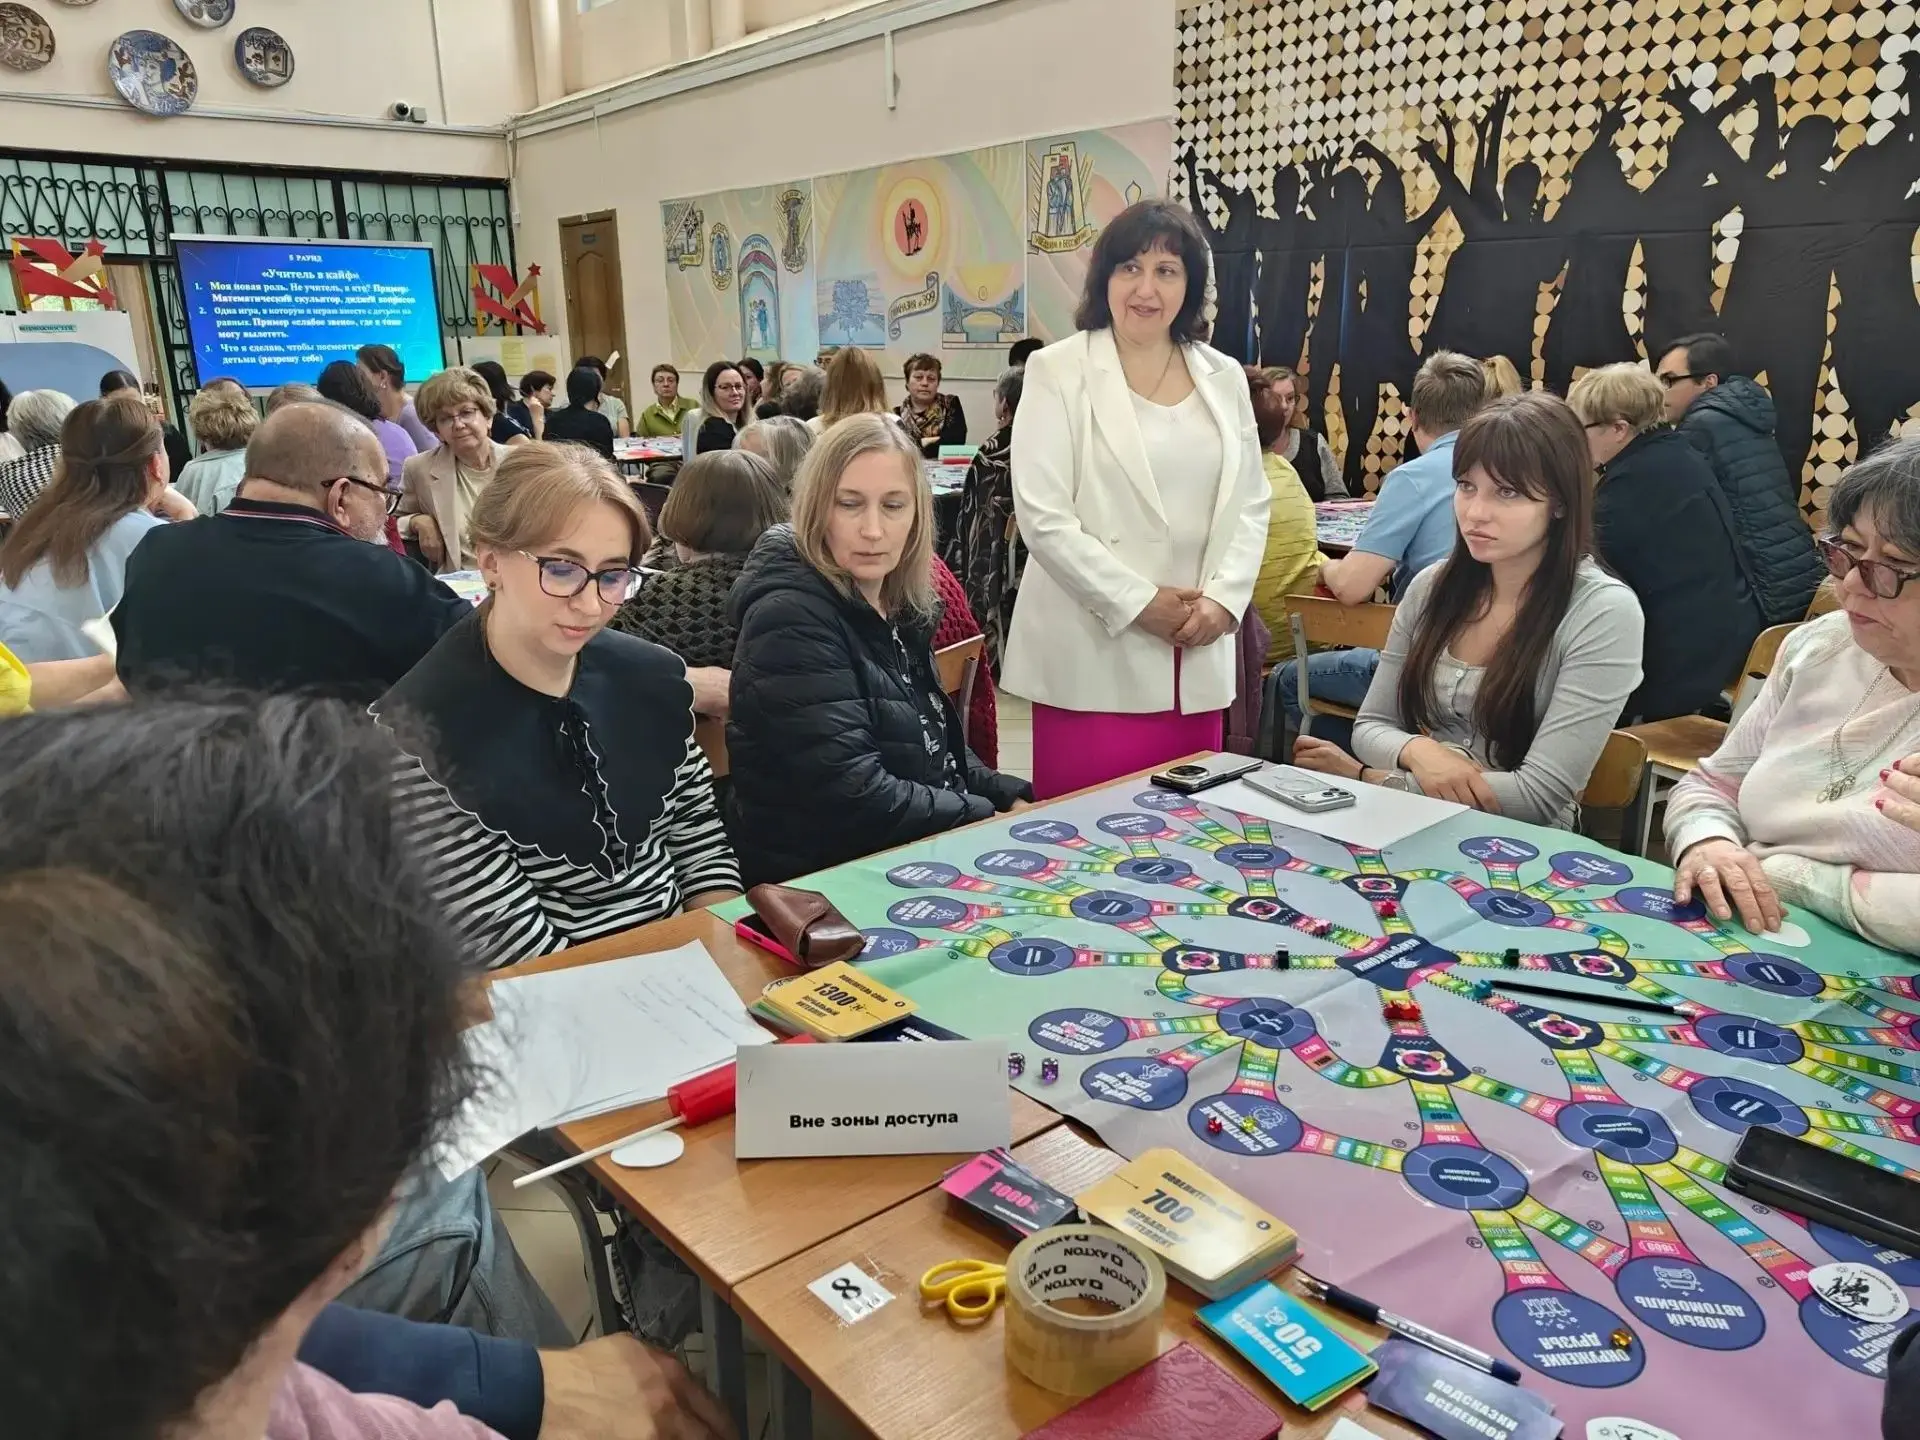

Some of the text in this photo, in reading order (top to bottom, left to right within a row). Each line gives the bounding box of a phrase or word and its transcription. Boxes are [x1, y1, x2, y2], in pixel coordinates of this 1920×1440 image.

[262, 269, 315, 279] «Учитель
[326, 271, 360, 281] кайф»
[210, 282, 231, 290] Моя
[212, 294, 292, 303] Математический
[214, 307, 236, 315] Одна
[238, 308, 260, 316] игра,
[252, 318, 289, 327] Пример
[218, 331, 240, 340] могу
[220, 344, 239, 352] Что
[222, 356, 256, 364] детьми
[302, 354, 323, 364] себе)
[813, 982, 858, 1007] 1300
[789, 1112, 959, 1129] Вне зоны доступа
[1437, 1134, 1462, 1142] 1200
[989, 1181, 1033, 1208] 1000
[1142, 1188, 1195, 1223] 700
[1064, 1247, 1107, 1259] AXTON
[831, 1277, 862, 1300] 8
[1045, 1278, 1086, 1293] AXTON
[1518, 1275, 1547, 1285] 1800
[1634, 1296, 1747, 1318] АВТОМОБИЛЬ
[1666, 1312, 1730, 1331] НОВЫЙ
[1538, 1332, 1602, 1350] ДРУЗЬЯ
[1848, 1322, 1896, 1343] СПОРТ
[1274, 1322, 1324, 1361] 50
[1533, 1349, 1632, 1368] ОКРУЖЕНИЕ,
[1432, 1379, 1519, 1432] ПОДСКАЗКИ
[1424, 1392, 1508, 1440] ВСЕЛЕННОЙ
